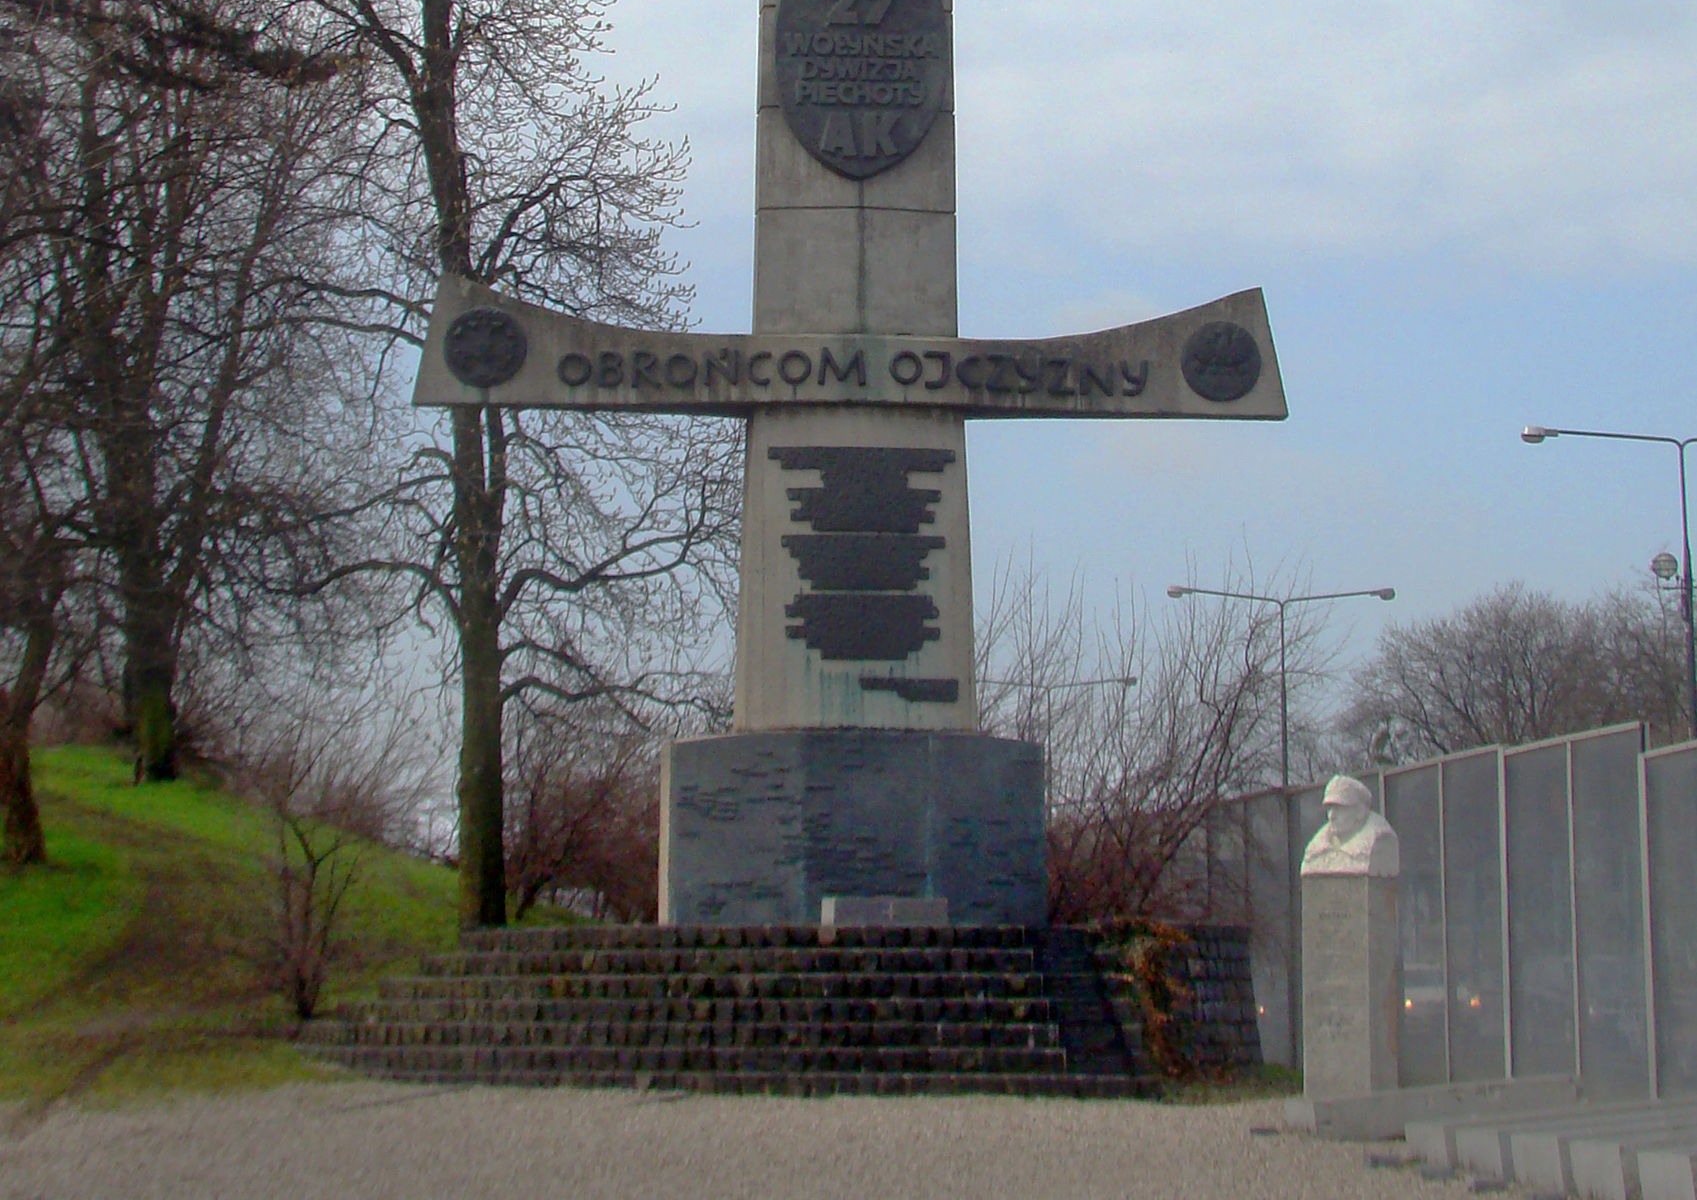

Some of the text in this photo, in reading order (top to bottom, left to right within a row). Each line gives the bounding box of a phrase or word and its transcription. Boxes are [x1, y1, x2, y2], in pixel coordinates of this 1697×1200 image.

[799, 57, 917, 80] DYWIZJA
[795, 80, 925, 106] PIECHOTY
[820, 111, 903, 157] AK
[888, 349, 1149, 397] OJCZYZNY
